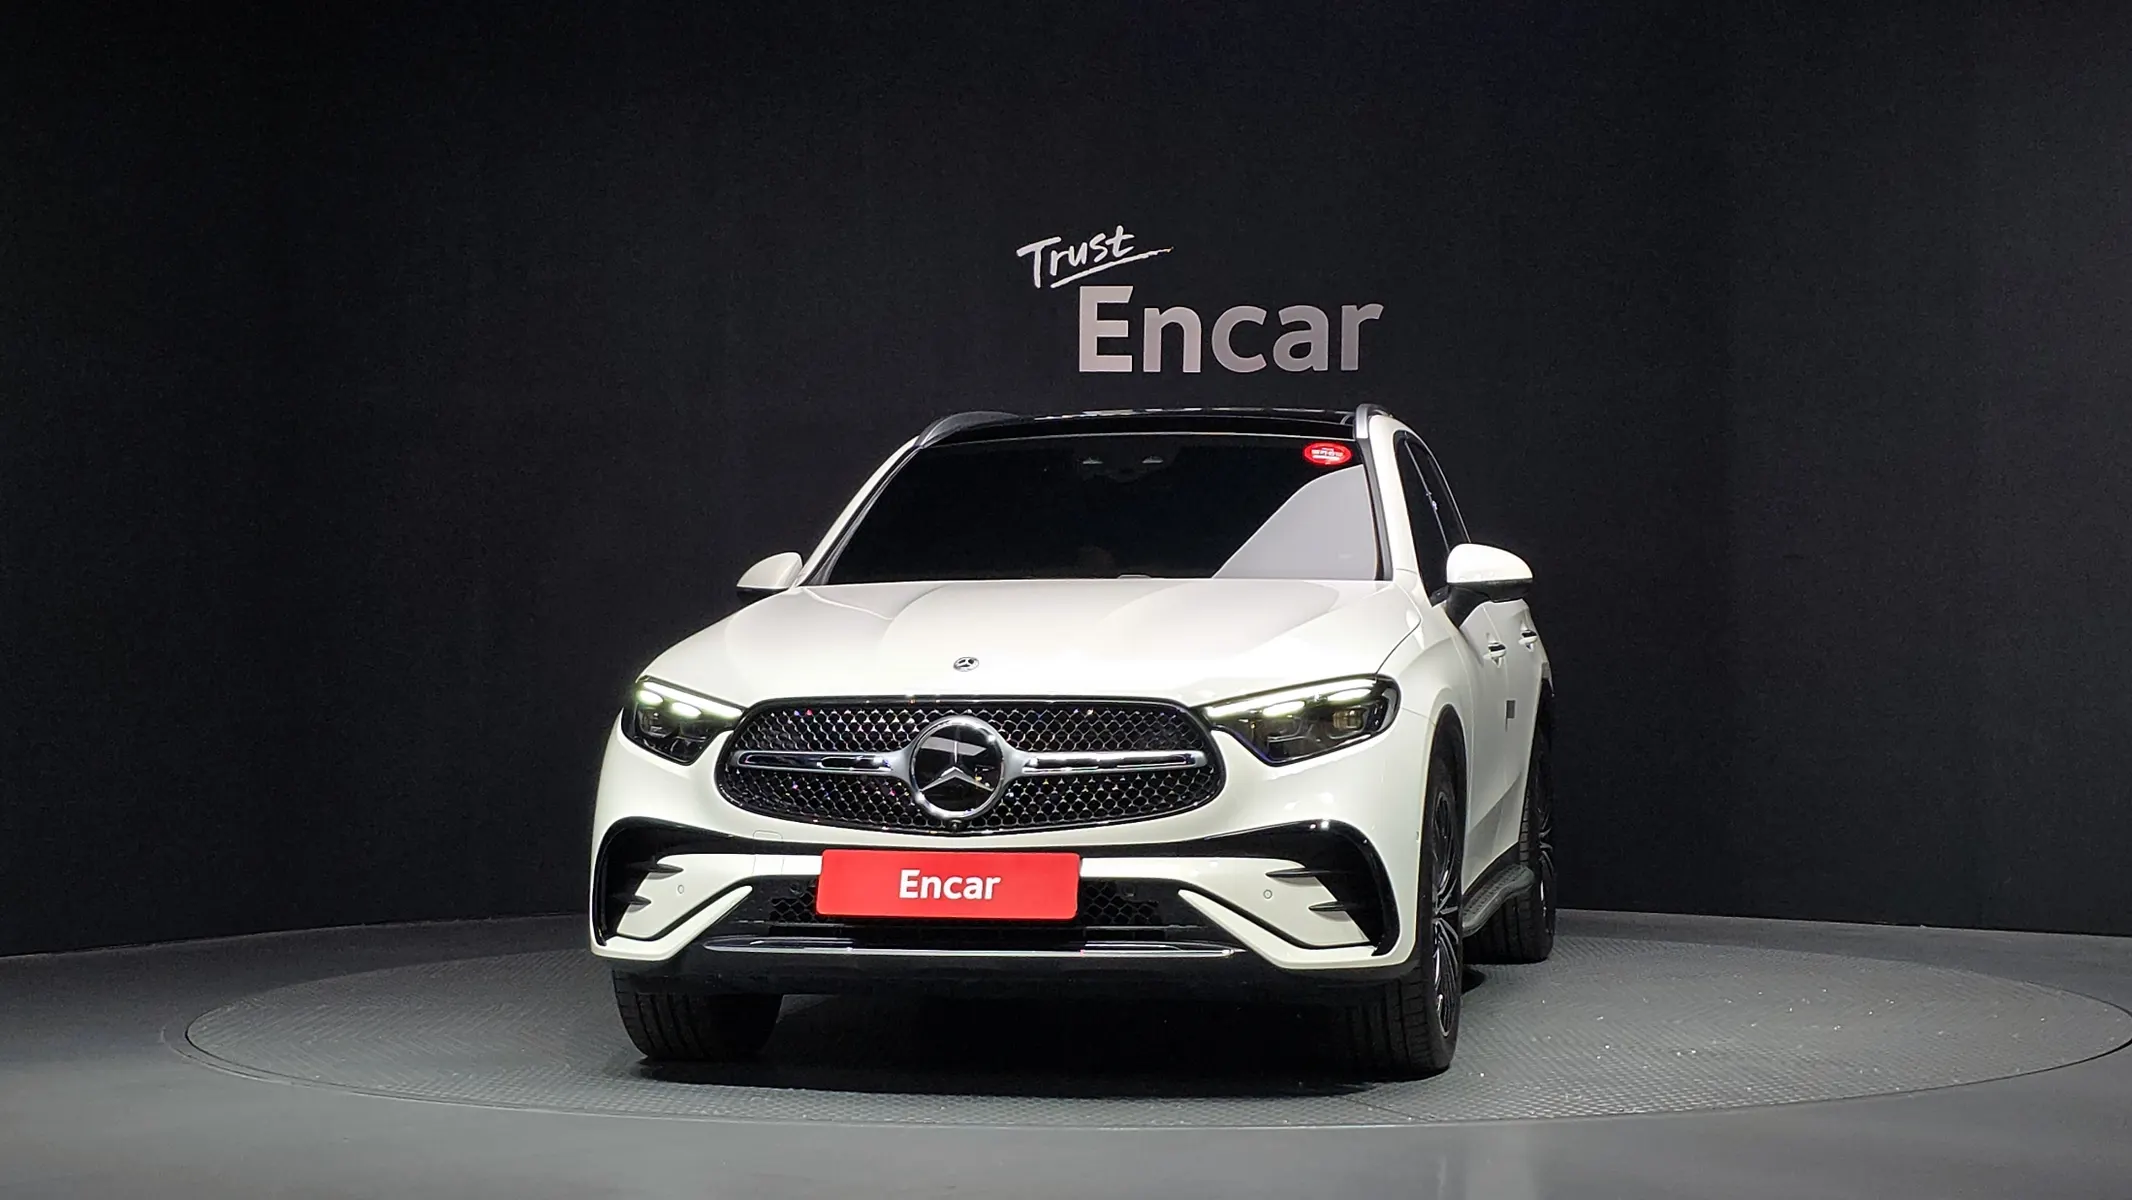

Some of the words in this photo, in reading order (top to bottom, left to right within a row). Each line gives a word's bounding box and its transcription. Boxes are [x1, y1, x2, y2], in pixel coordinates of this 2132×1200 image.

[1016, 225, 1136, 288] Trust
[1078, 285, 1384, 373] Encar
[898, 868, 1002, 901] Encar
